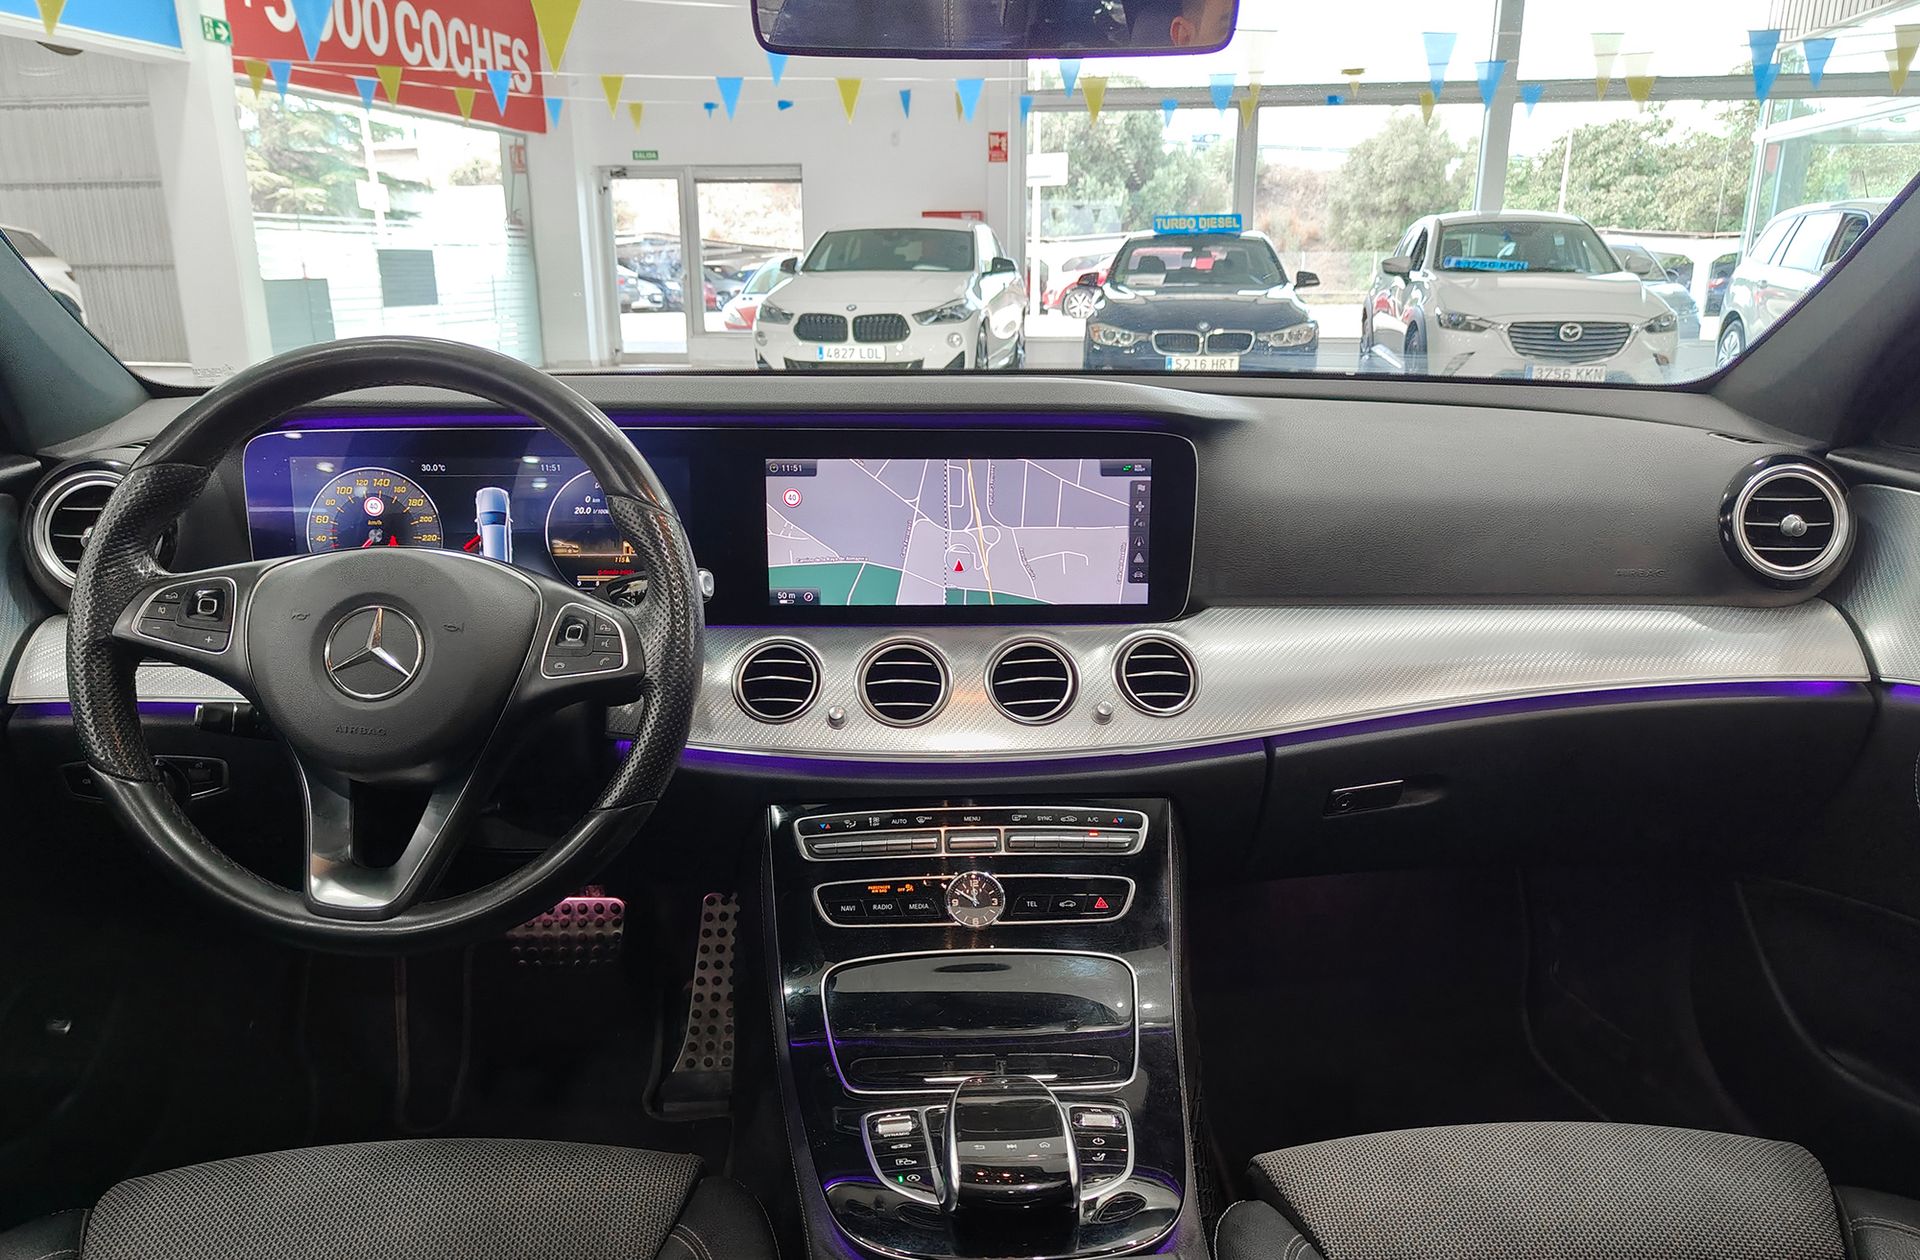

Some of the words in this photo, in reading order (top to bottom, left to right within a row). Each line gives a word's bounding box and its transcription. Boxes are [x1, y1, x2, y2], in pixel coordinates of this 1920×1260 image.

[395, 9, 532, 93] COCHES
[1156, 217, 1196, 230] TURBO
[1199, 216, 1240, 229] DIESEL
[826, 347, 855, 359] 4827
[1175, 358, 1207, 371] 5216
[1211, 358, 1235, 370] HRT
[1535, 367, 1571, 381] 3756
[1575, 368, 1605, 381] KKN
[540, 464, 561, 472] 11:51
[781, 464, 802, 472] 11:51
[356, 479, 369, 487] 120
[373, 478, 391, 487] 140
[336, 486, 353, 495] 100
[408, 498, 424, 507] 180
[585, 495, 592, 503] 0
[574, 506, 592, 515] 20.0
[315, 515, 330, 524] 60
[419, 515, 434, 523] 200
[422, 534, 438, 542] 220
[777, 591, 787, 599] 50
[335, 724, 387, 737] AIRBAG
[891, 818, 908, 826] AUTO
[951, 898, 959, 907] 9
[991, 897, 999, 906] 3
[1026, 900, 1038, 908] TEL
[840, 904, 856, 912] NAVI
[872, 903, 893, 911] RADIO
[972, 917, 979, 925] 6
